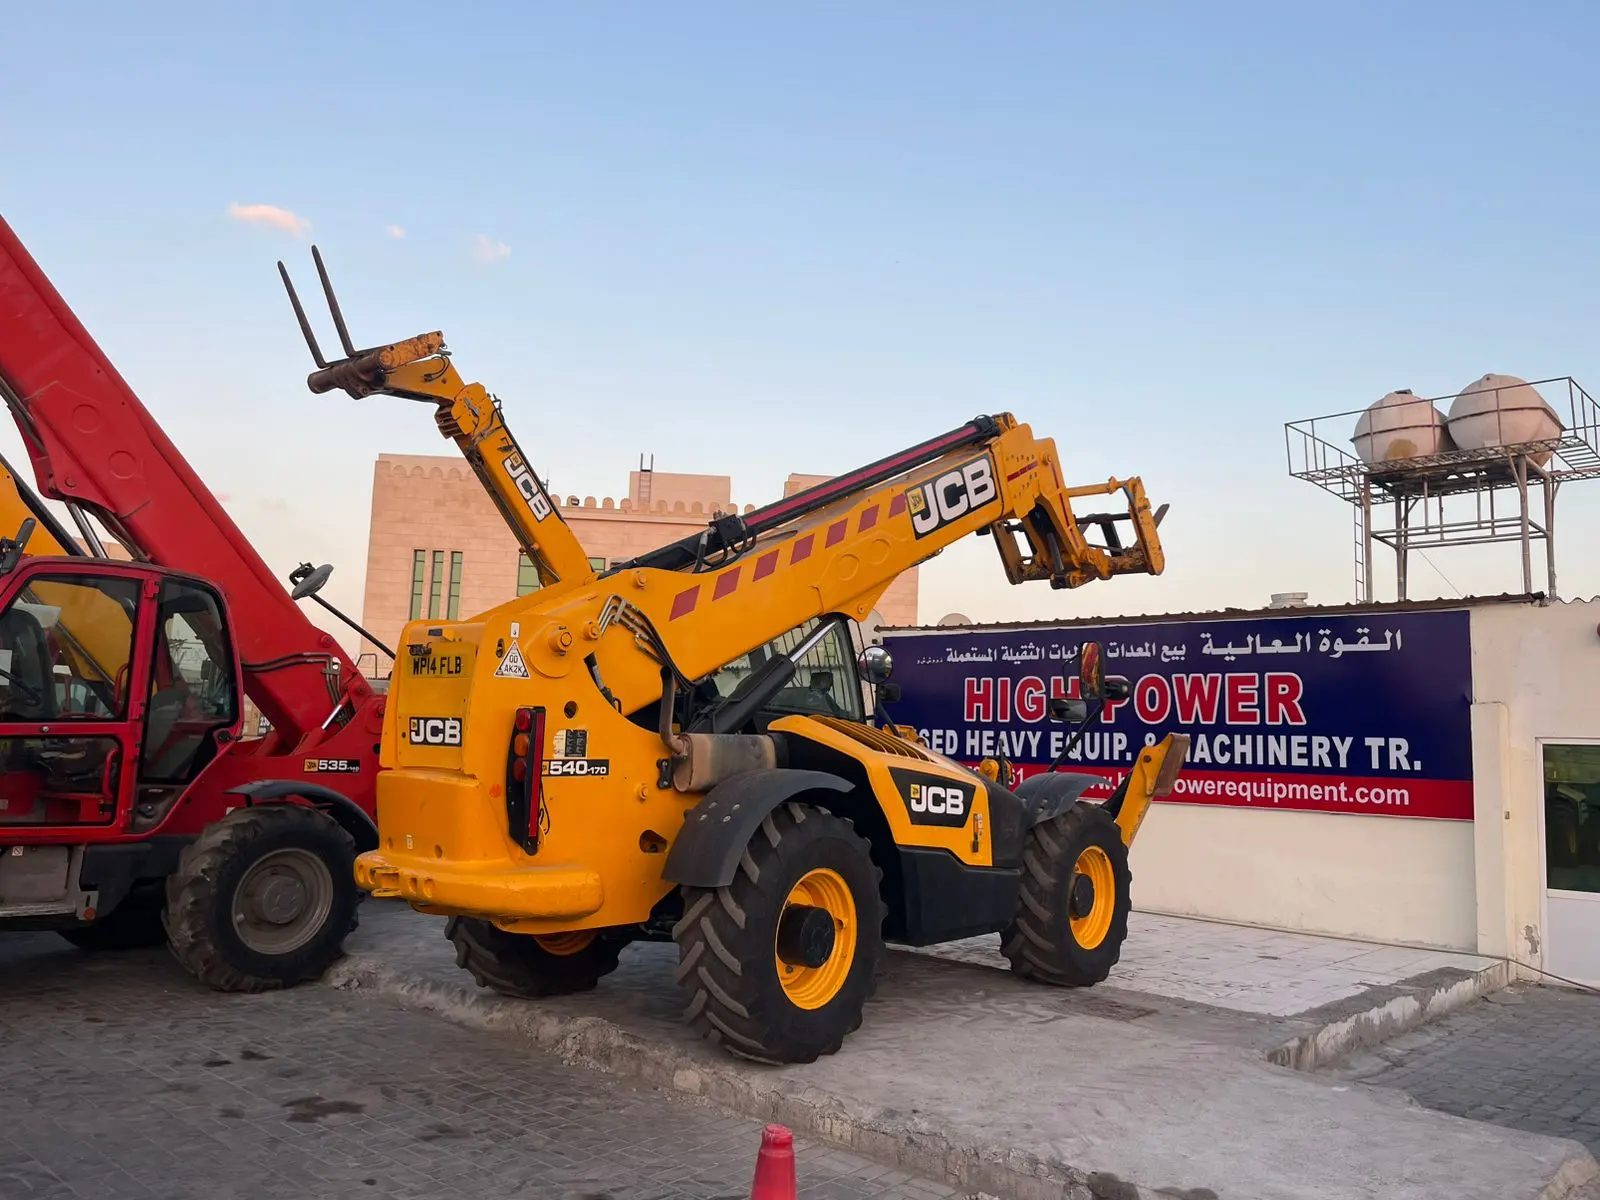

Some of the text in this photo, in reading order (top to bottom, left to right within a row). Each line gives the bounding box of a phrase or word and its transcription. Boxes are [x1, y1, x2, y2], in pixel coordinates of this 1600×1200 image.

[504, 457, 551, 522] JCB
[911, 458, 996, 534] JCB
[946, 647, 998, 663] المستعملة
[1001, 642, 1045, 665] الثقيلة
[1106, 641, 1156, 660] المعدات
[1160, 642, 1187, 663] بيع
[1200, 631, 1311, 662] العالية
[1317, 627, 1402, 658] القوة
[412, 656, 462, 675] WP14 FLB
[1101, 672, 1307, 725] POWER
[410, 718, 461, 744] JCB
[918, 728, 959, 755] SED
[966, 729, 1042, 758] HEAVY
[1050, 731, 1132, 761] EQUIP.
[1183, 733, 1354, 768] ACHINERY
[1364, 737, 1422, 771] TR.
[550, 761, 607, 775] 540-170
[910, 785, 964, 815] JCB
